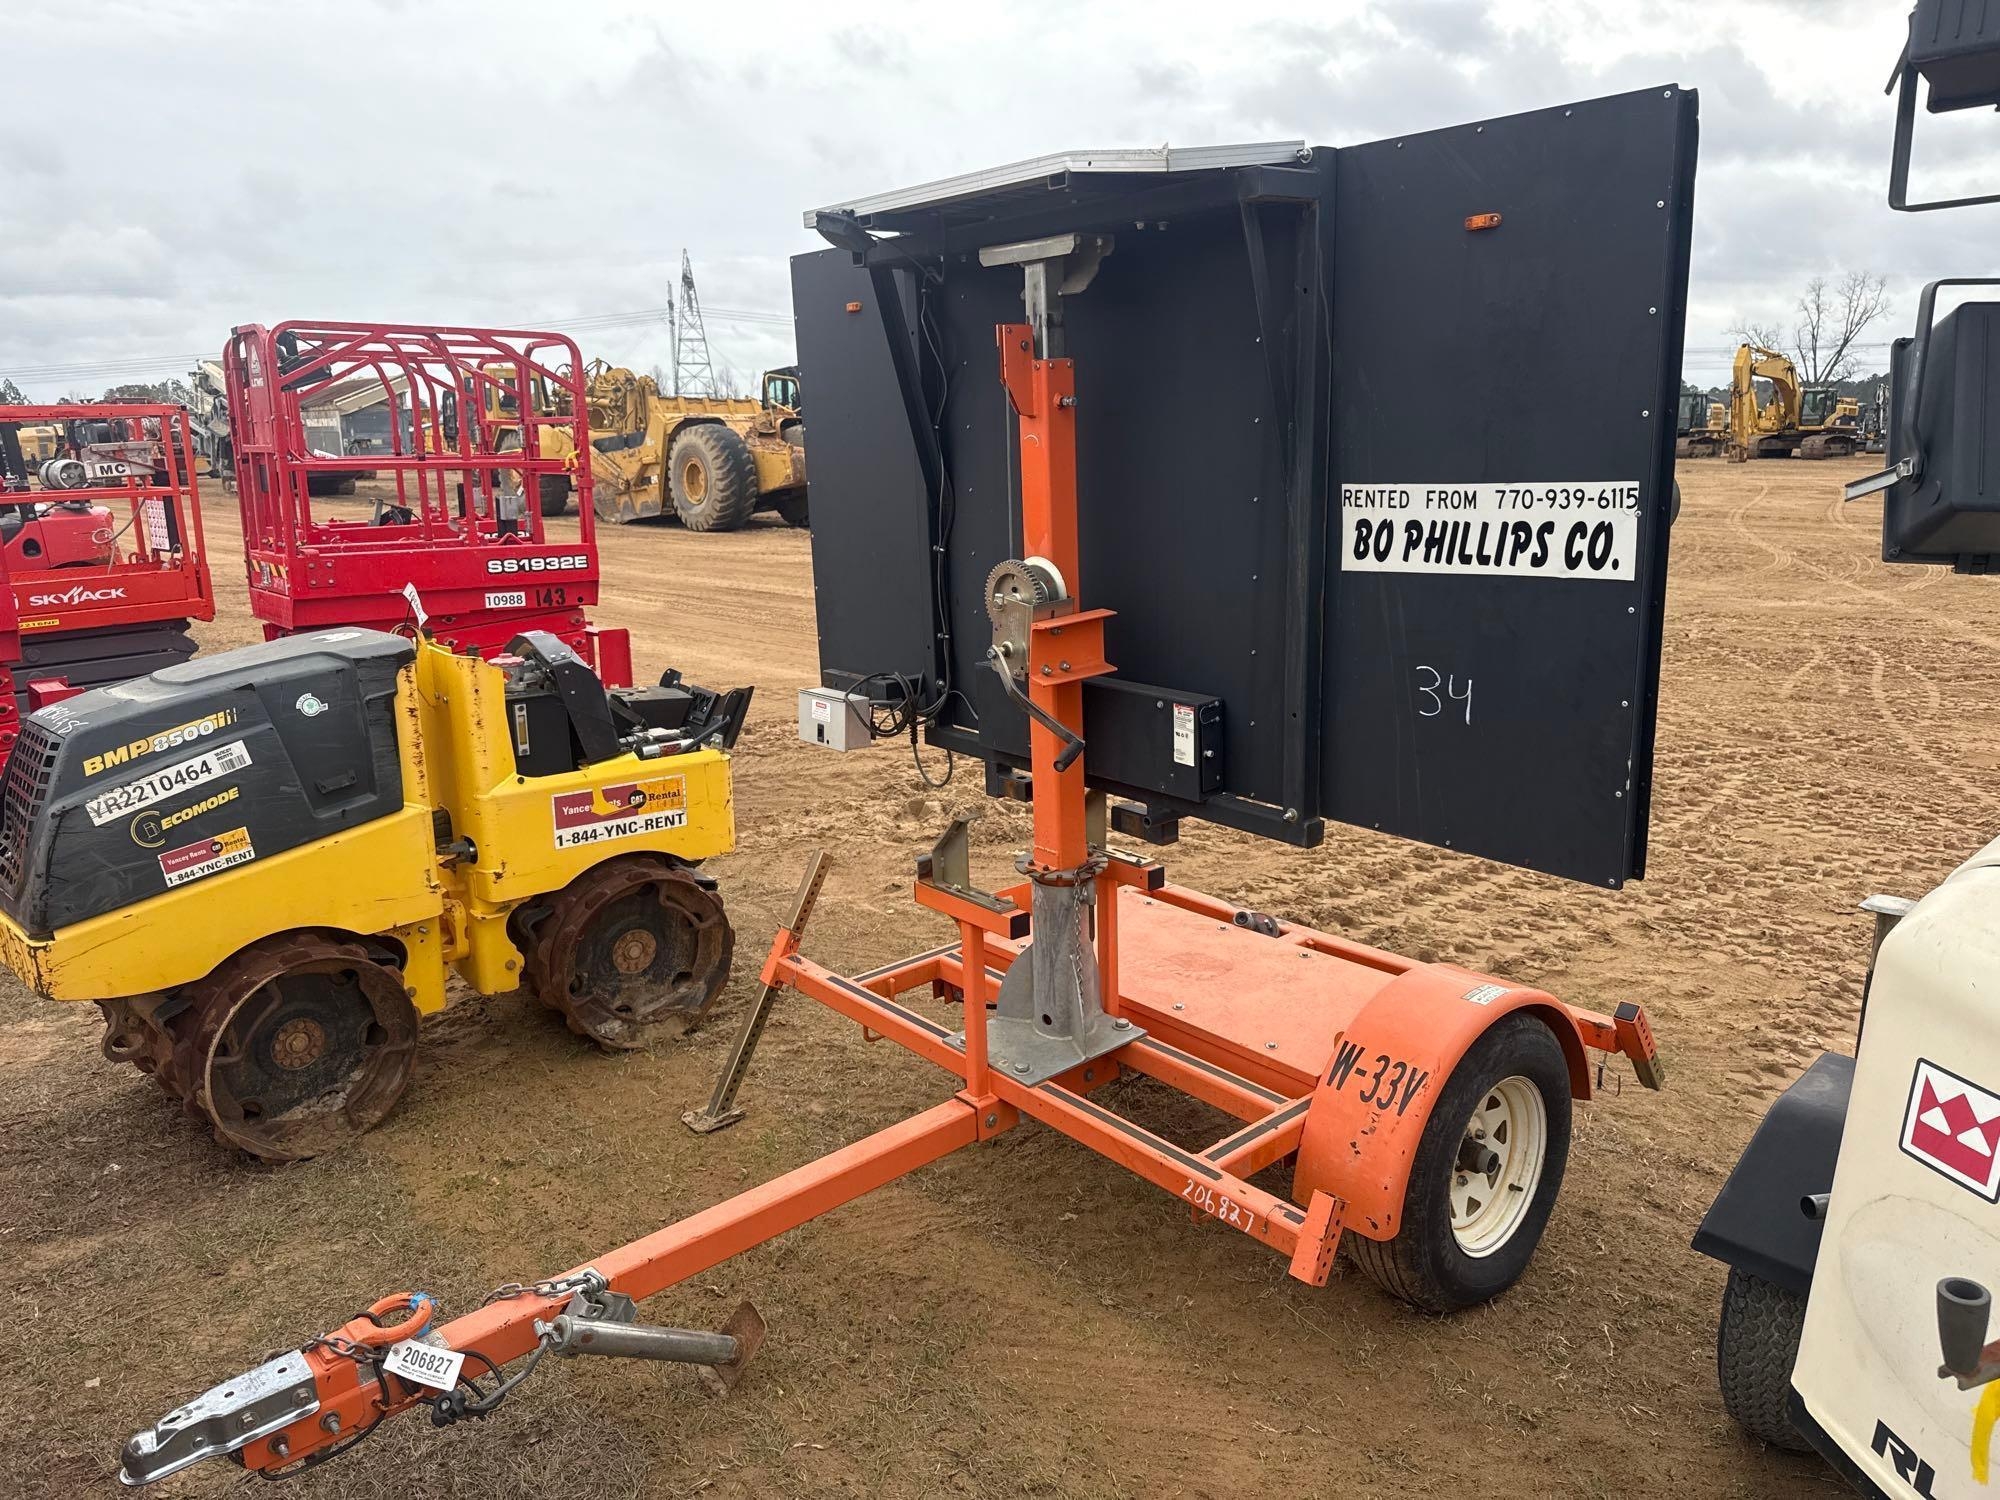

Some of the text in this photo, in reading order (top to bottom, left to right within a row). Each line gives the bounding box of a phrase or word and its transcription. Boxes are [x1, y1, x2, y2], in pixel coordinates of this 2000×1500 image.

[99, 463, 126, 476] MC
[1342, 487, 1639, 510] RENTED FROM 770-939-6115
[1353, 517, 1620, 571] BO PHILLIPS CO.
[487, 555, 588, 574] SS1932E
[29, 585, 128, 607] SKYJACK
[486, 594, 524, 606] 10988
[535, 587, 567, 607] 143
[1416, 665, 1473, 726] 34
[90, 759, 213, 819] YR2210464
[630, 794, 644, 804] CAT
[648, 788, 681, 802] Rental
[161, 786, 240, 831] ECOMODE
[556, 812, 685, 847] 1-844-YNC-RENT
[223, 835, 247, 848] Rental
[167, 849, 207, 866] Yancey Rents
[167, 849, 253, 885] 1-844-YNC-RENT
[1326, 1040, 1430, 1118] W-33V
[1181, 1178, 1255, 1233] 206827
[402, 1346, 454, 1375] 206827
